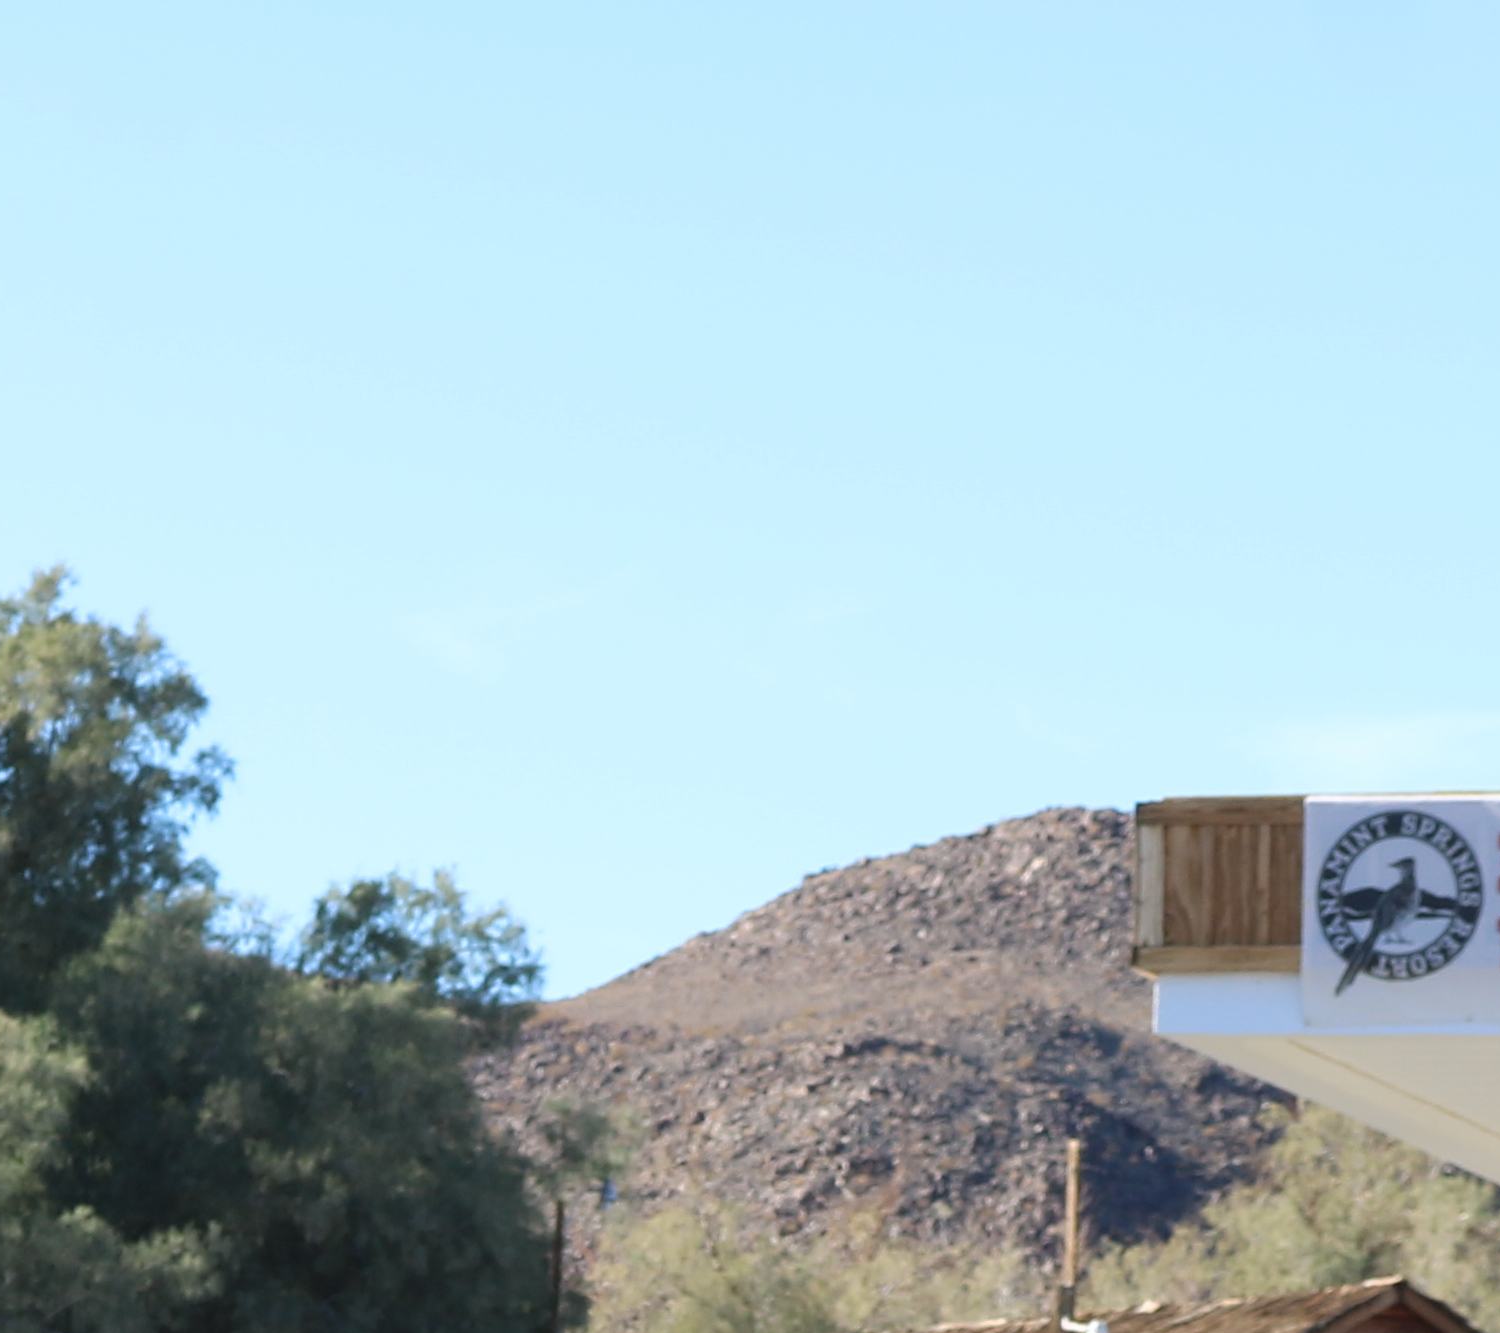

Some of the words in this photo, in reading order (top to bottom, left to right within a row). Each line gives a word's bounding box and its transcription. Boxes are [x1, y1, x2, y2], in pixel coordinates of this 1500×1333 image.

[1319, 815, 1389, 950] PANAMINT
[1401, 812, 1481, 907] SPRINGS
[1370, 915, 1475, 978] RESORT
